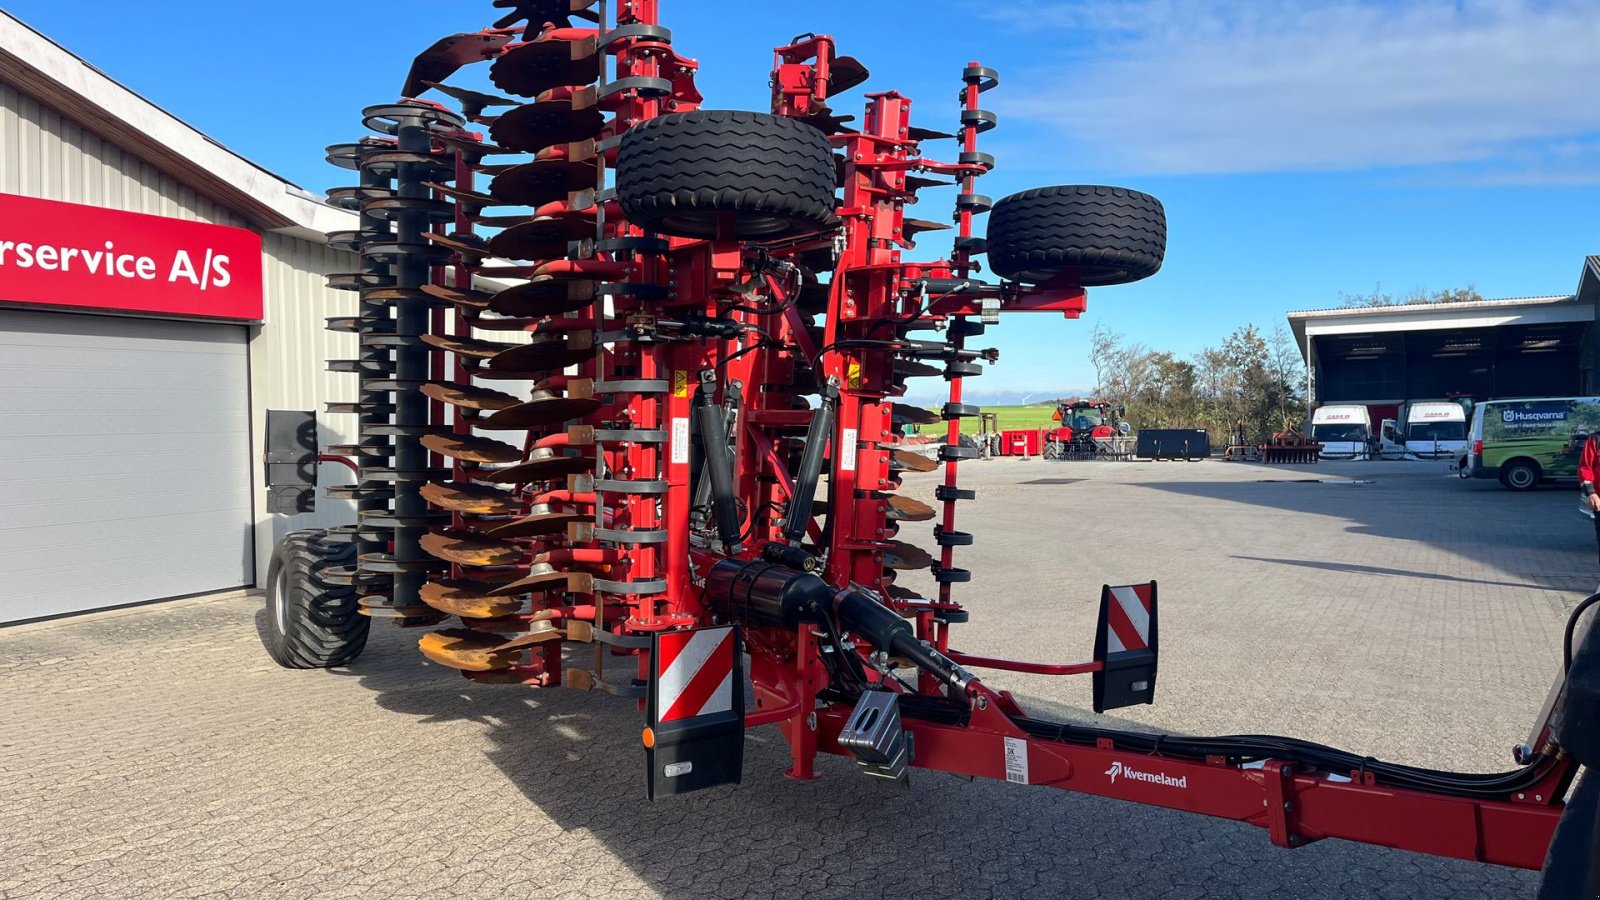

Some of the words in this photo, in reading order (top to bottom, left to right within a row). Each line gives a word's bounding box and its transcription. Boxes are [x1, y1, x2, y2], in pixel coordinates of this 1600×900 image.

[168, 248, 231, 291] A/S
[1515, 411, 1565, 421] Husqvarna
[1123, 766, 1187, 788] Kverneland
